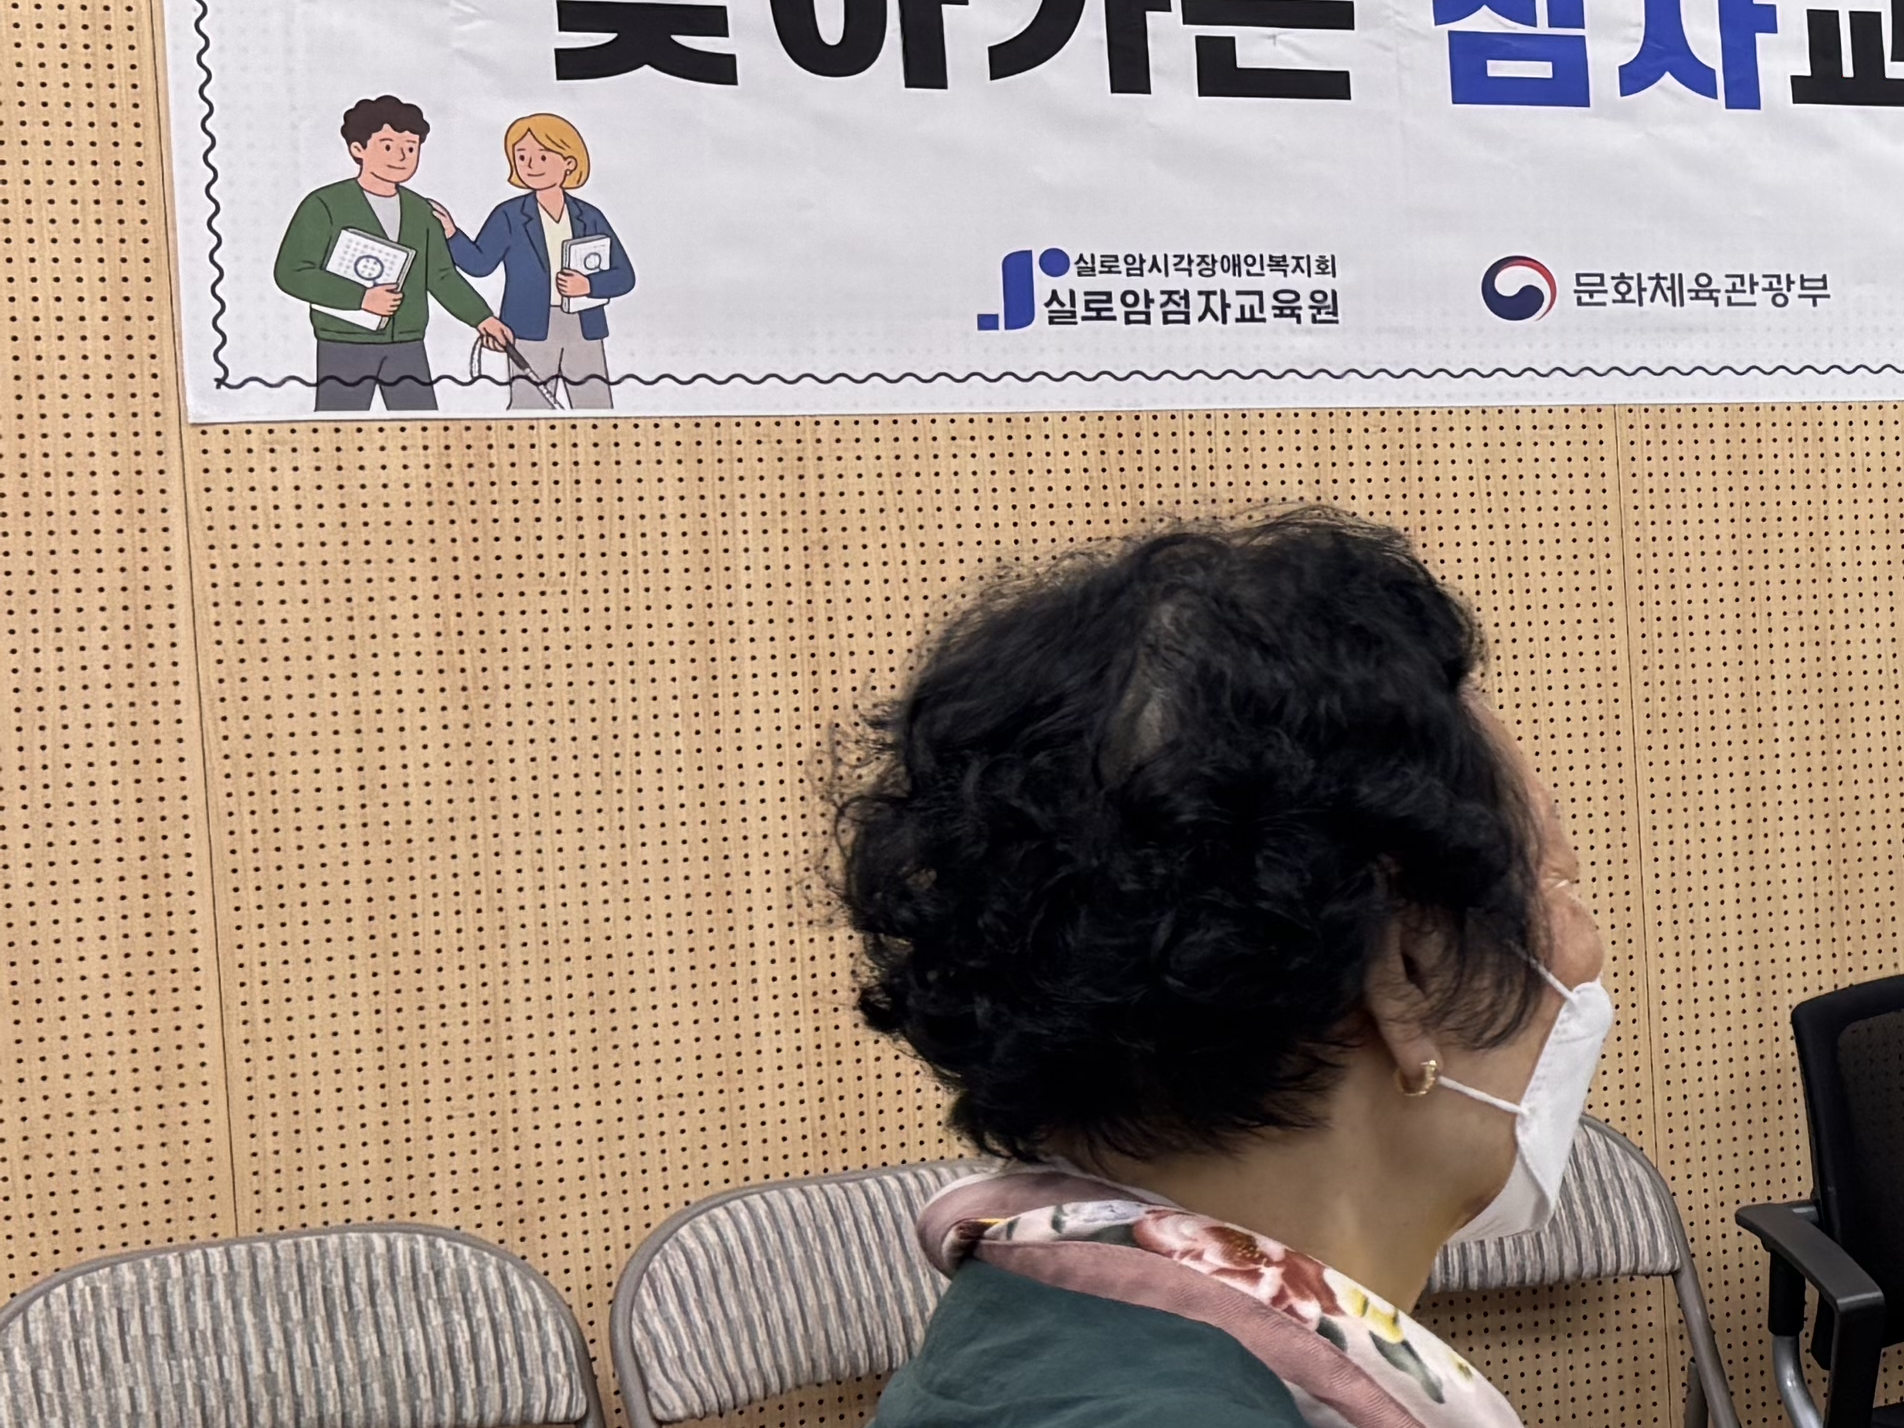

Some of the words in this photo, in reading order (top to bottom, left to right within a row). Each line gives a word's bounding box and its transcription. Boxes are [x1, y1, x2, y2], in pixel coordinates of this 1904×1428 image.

[1073, 252, 1337, 279] 실로암시각장애인복지회
[1043, 288, 1340, 326] 실로암점자교육원
[1573, 271, 1831, 308] 문화체육관광부
